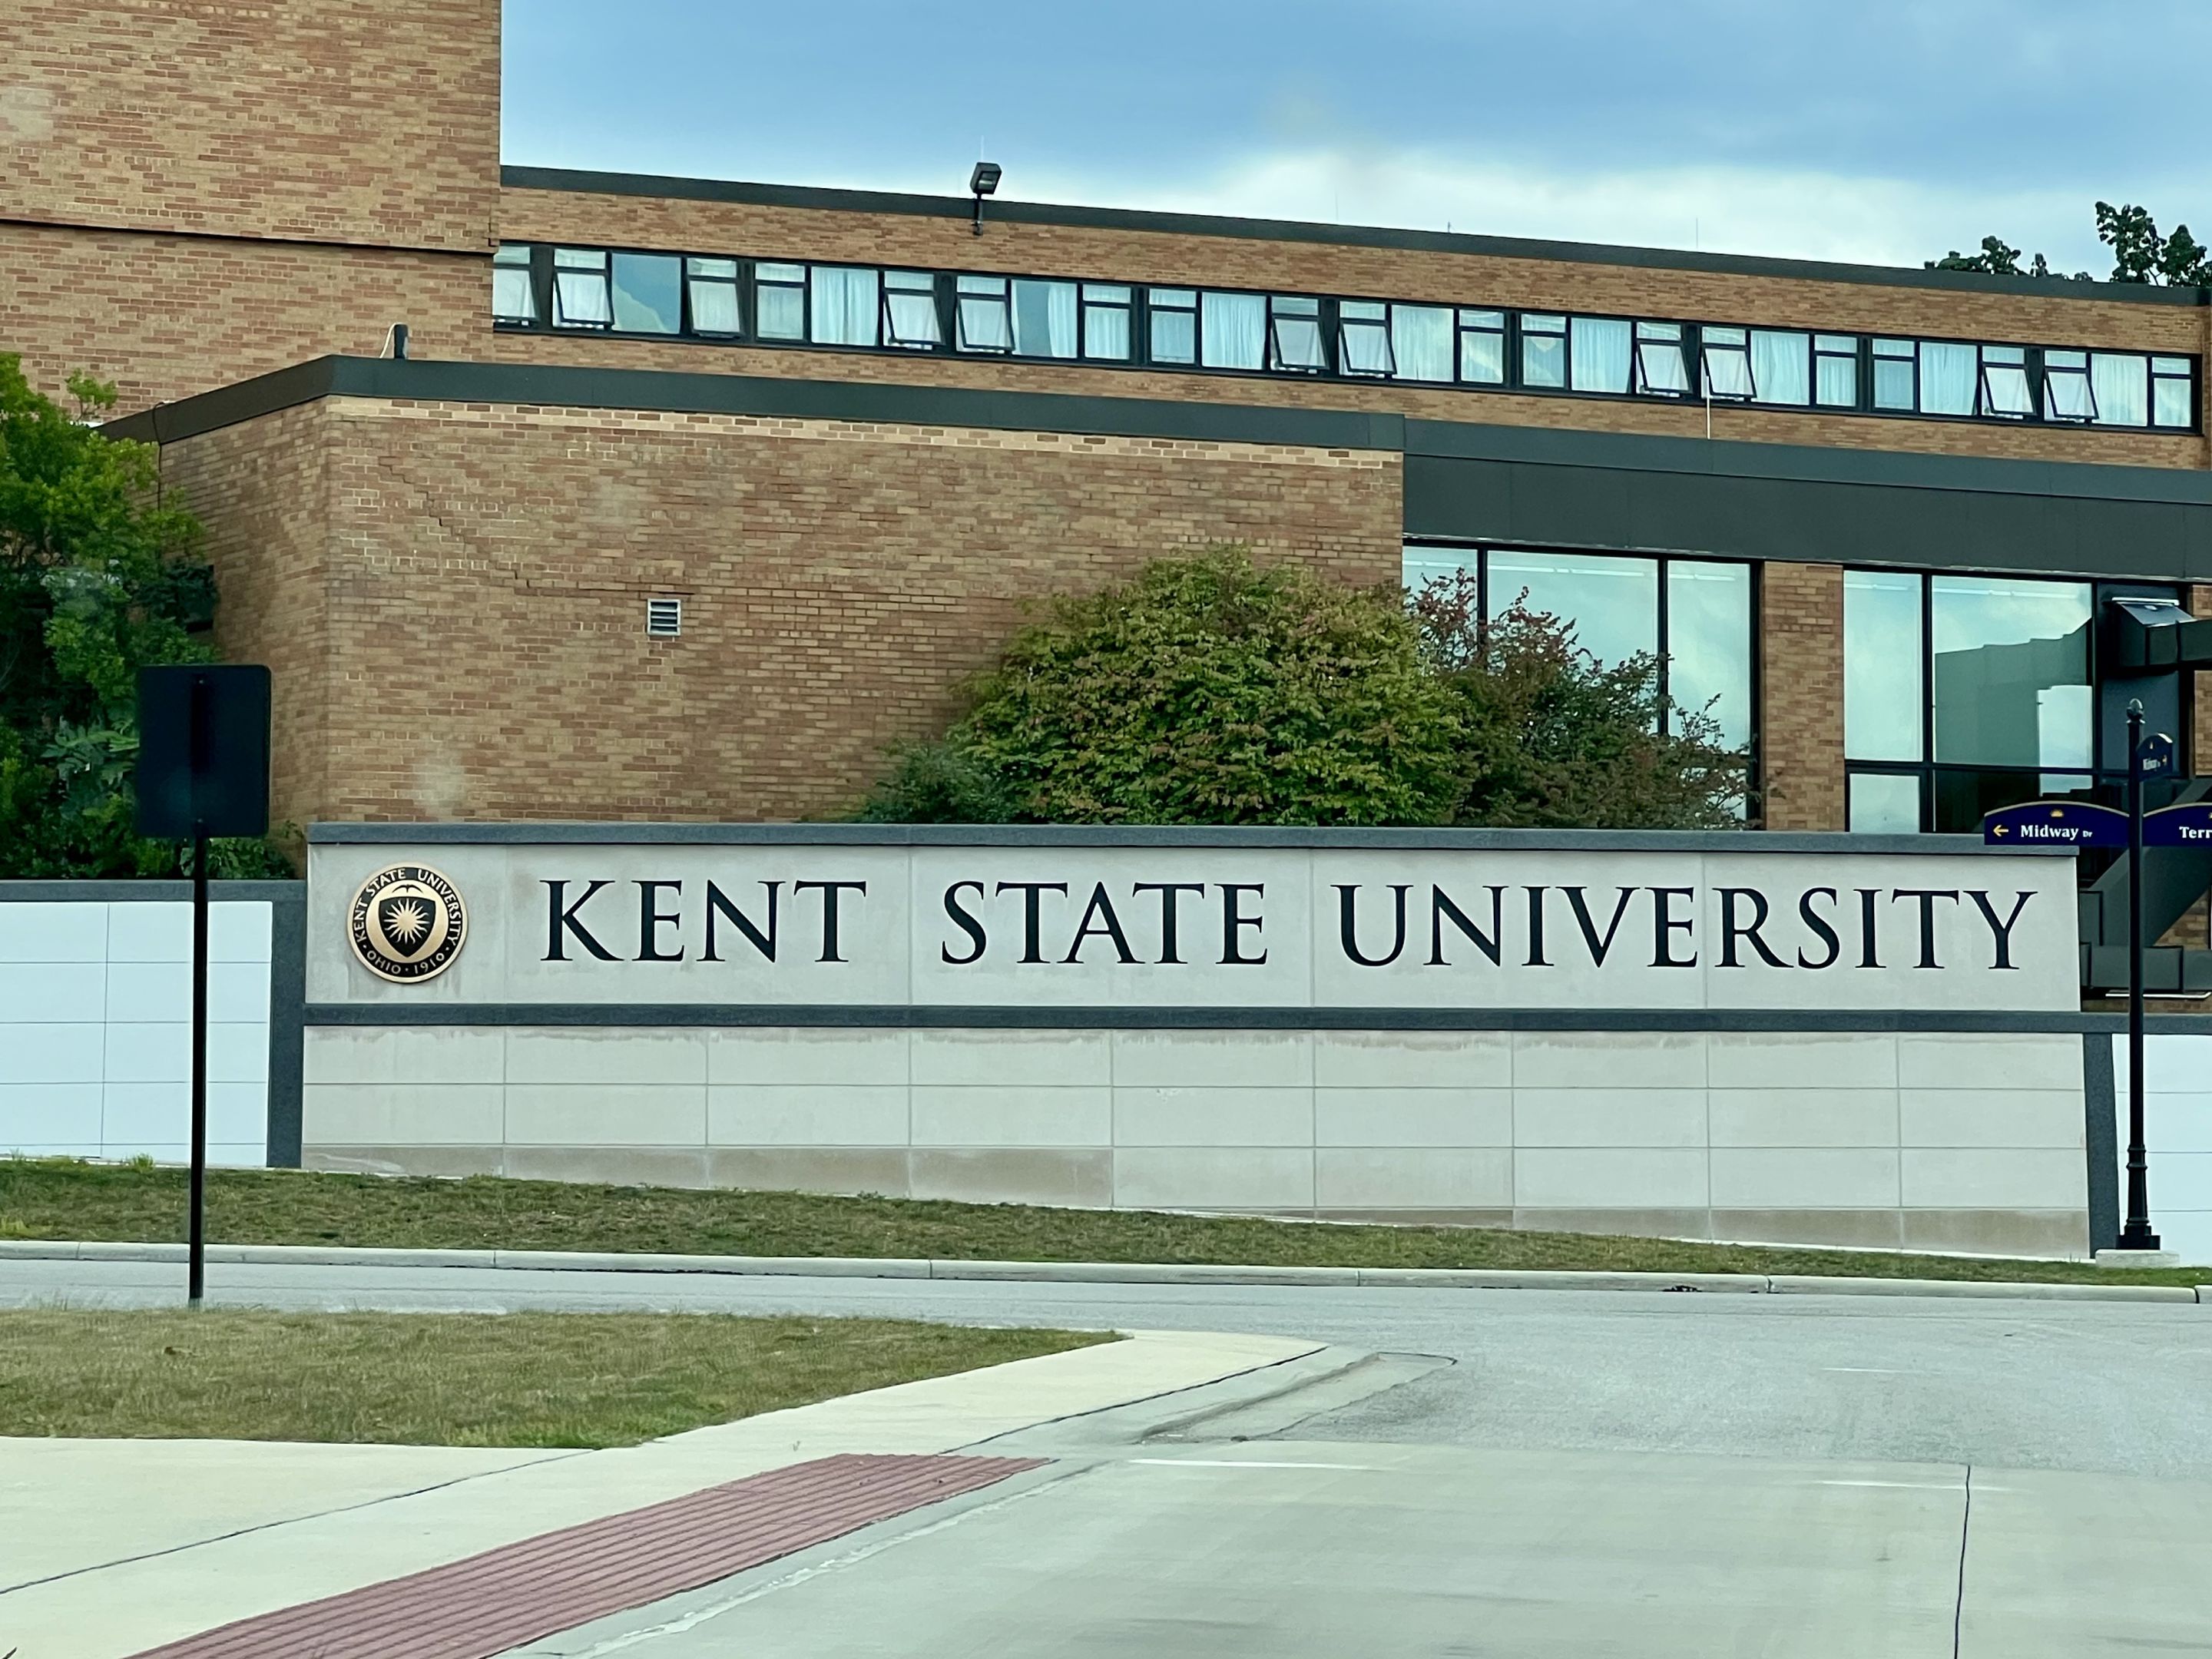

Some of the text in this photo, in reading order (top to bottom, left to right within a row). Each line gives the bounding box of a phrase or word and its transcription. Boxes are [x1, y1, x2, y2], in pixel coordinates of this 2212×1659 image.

[2021, 824, 2079, 840] Midway
[353, 869, 462, 946] KENT STATE UNIVERSITY
[540, 880, 2038, 969] KENT STATE UNIVERSITY
[366, 950, 445, 975] OHIO 1910
